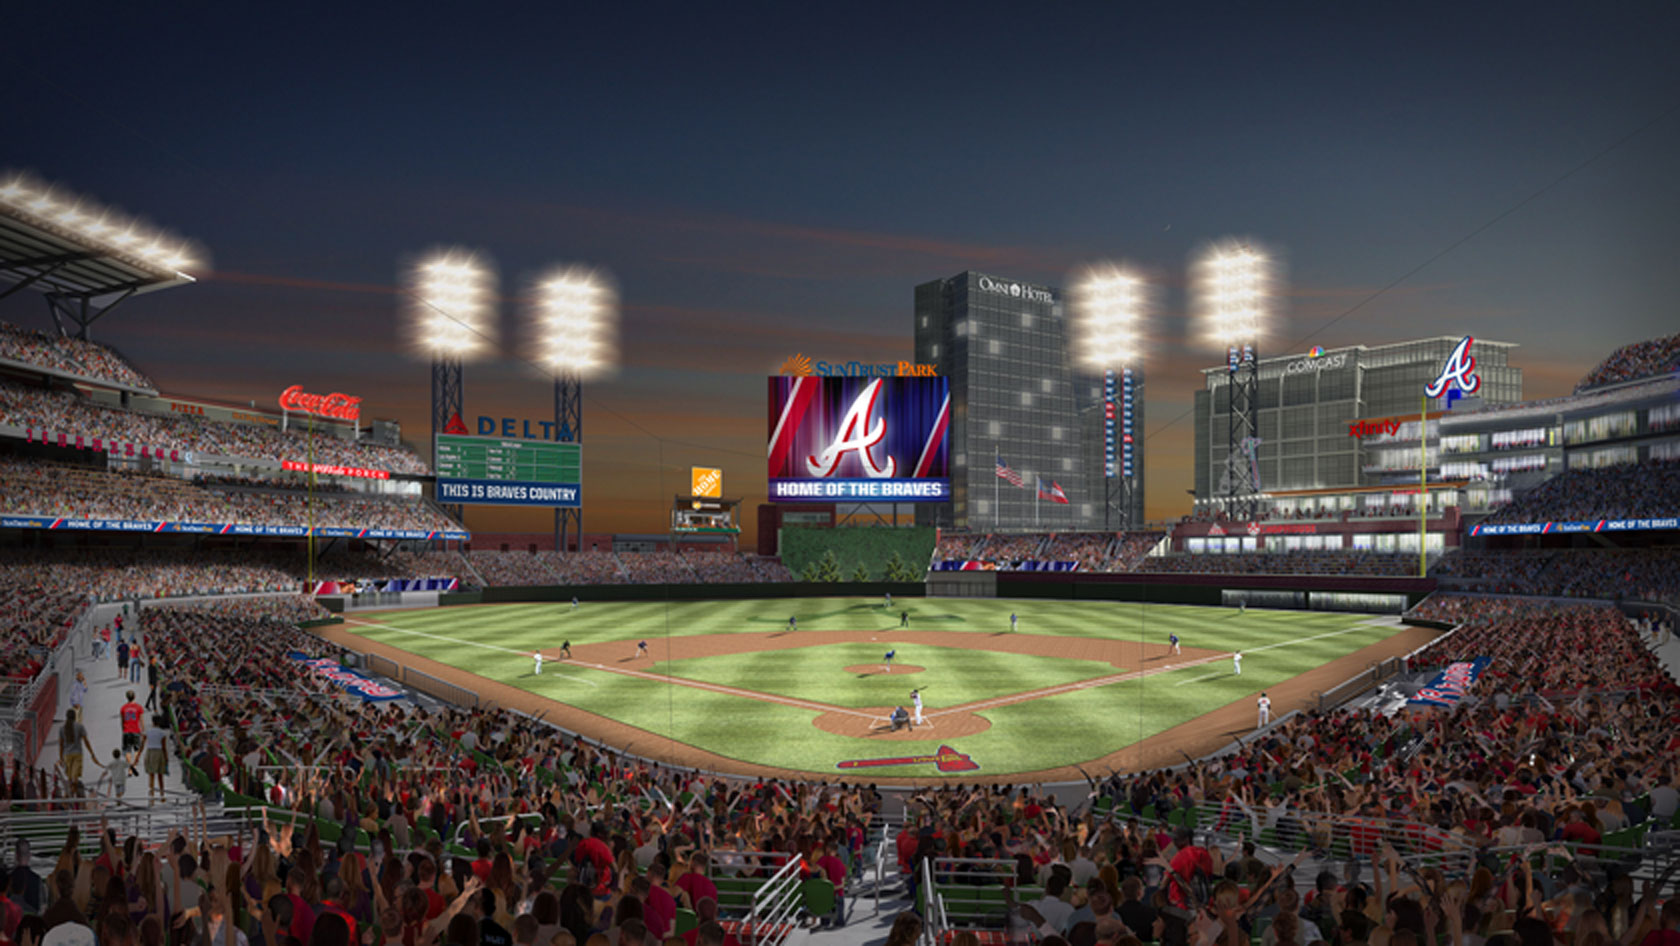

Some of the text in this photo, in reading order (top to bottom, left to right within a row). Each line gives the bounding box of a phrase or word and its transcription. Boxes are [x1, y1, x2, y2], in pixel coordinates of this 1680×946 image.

[1287, 354, 1347, 374] COMCAST
[478, 416, 574, 442] DELTA
[1348, 418, 1401, 439] xfinity
[442, 484, 577, 501] THIS IS BRAVES COUNTRY
[777, 482, 942, 496] HOME OF THE BRAVES
